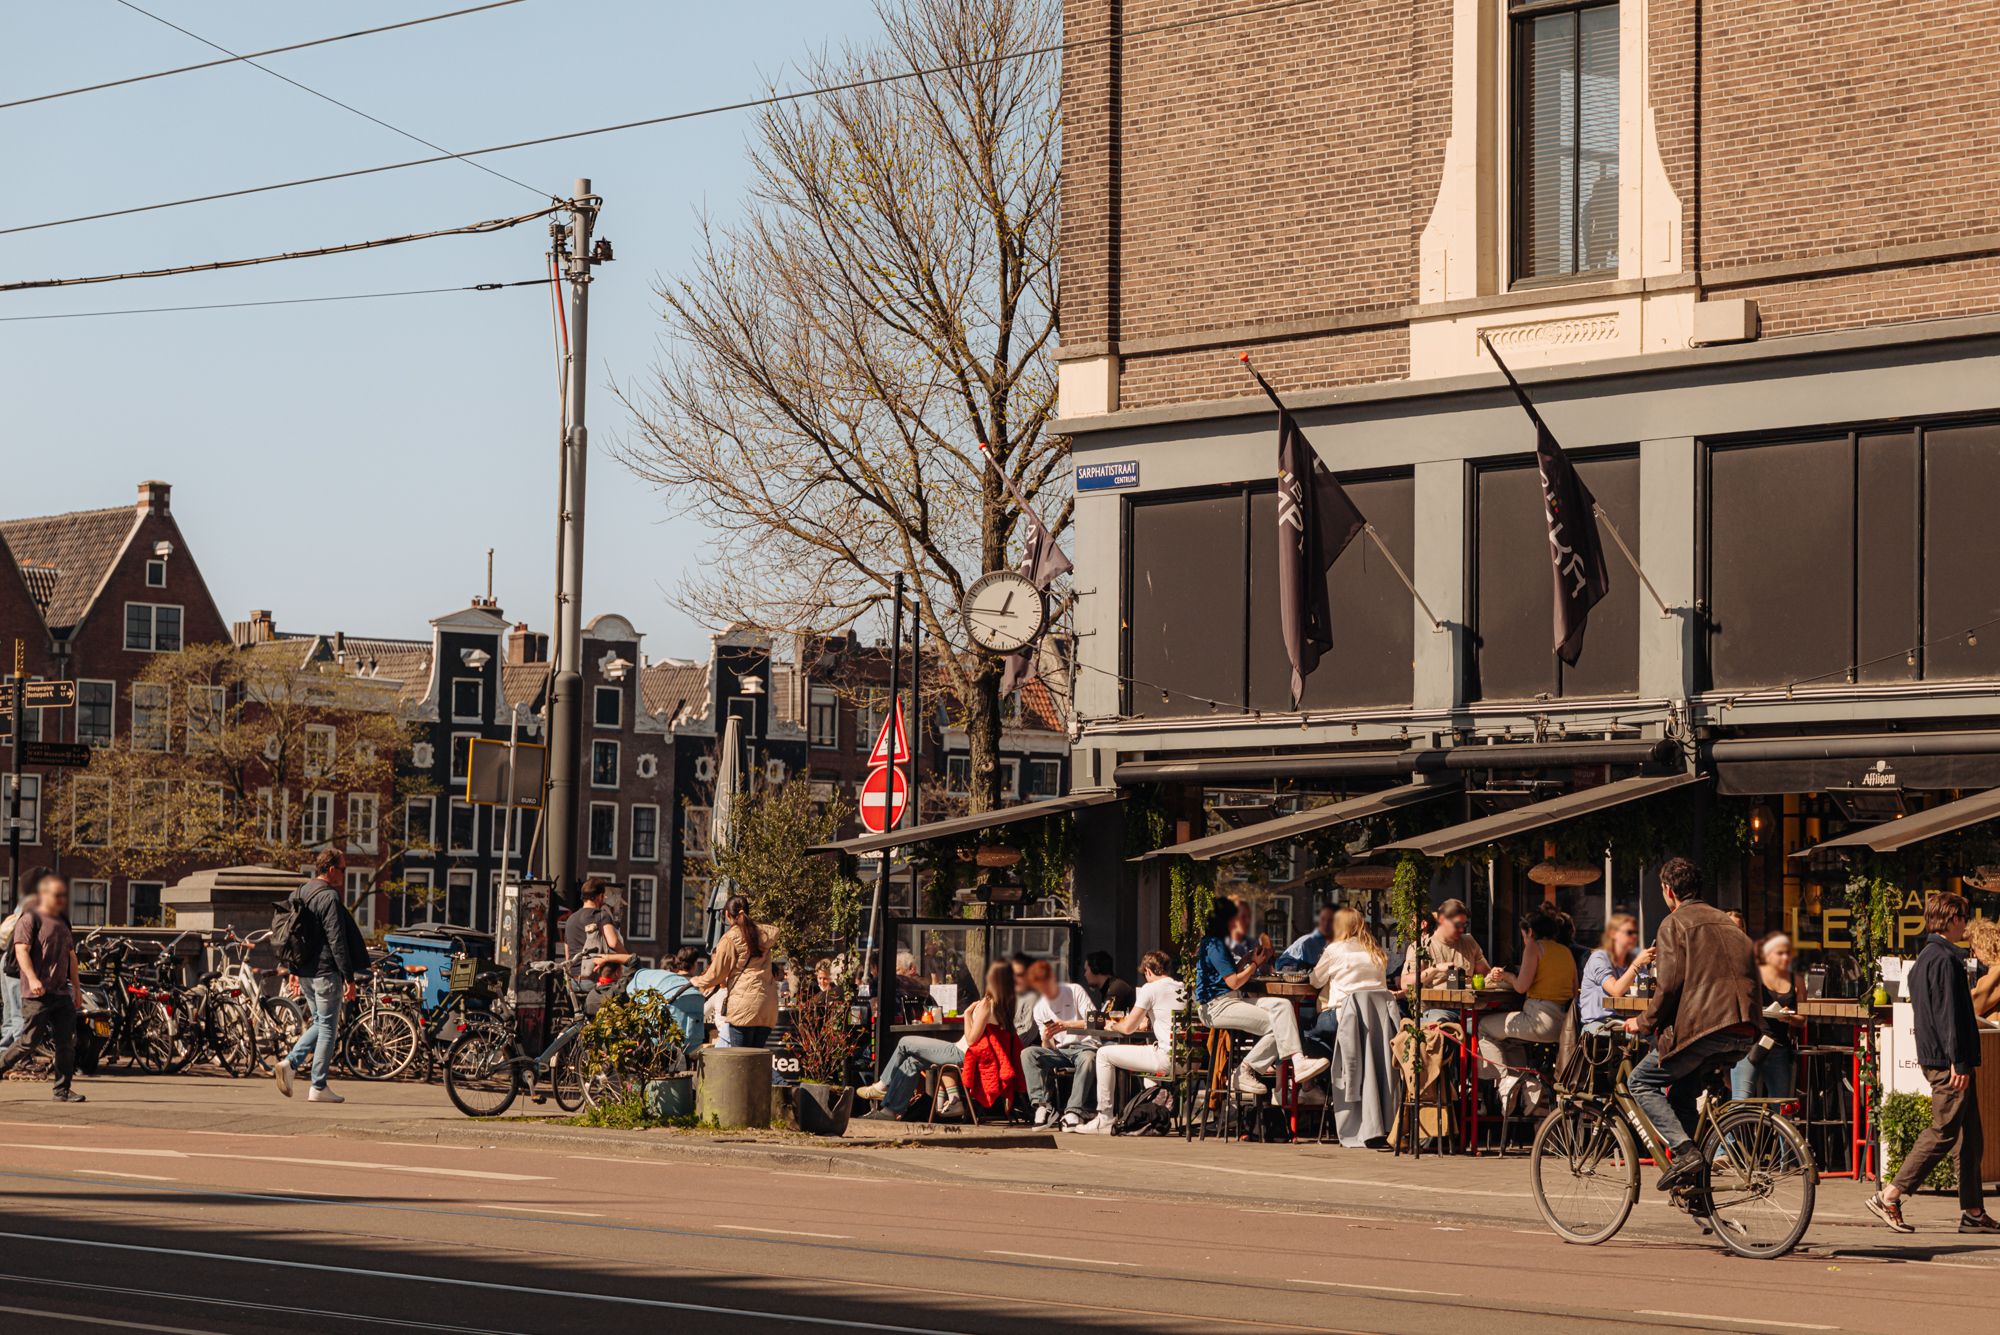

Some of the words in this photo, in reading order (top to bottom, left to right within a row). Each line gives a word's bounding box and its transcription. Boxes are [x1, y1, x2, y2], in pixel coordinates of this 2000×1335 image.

[1078, 463, 1136, 479] SARPHATISTRAAT
[1114, 475, 1136, 484] CENTRUM
[1862, 773, 1896, 786] Affligem
[772, 1054, 799, 1072] tea
[1627, 1110, 1654, 1150] SPIRIT
